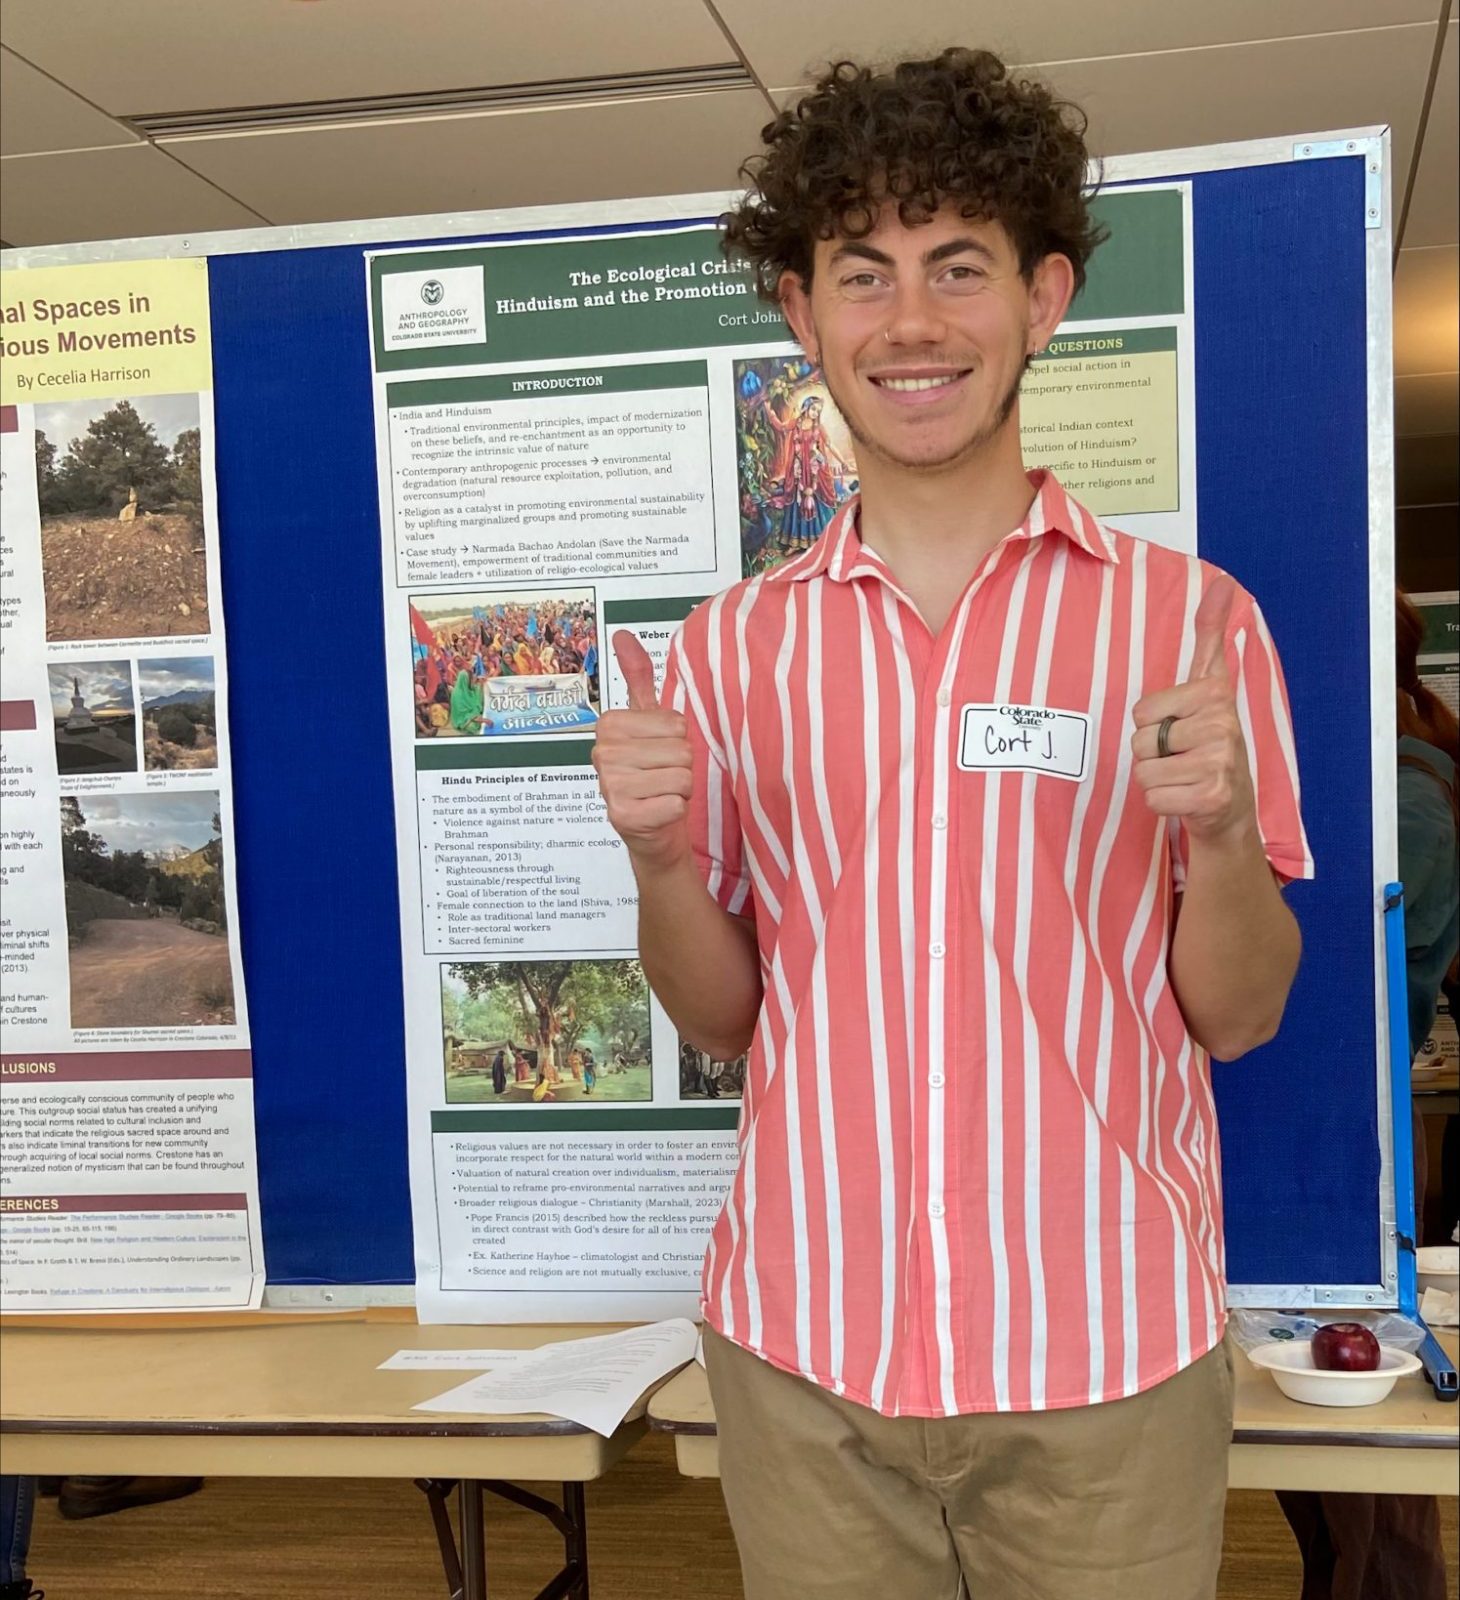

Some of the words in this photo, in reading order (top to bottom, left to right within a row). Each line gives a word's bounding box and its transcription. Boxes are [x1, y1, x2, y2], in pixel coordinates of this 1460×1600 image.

[570, 271, 602, 287] The
[607, 262, 696, 284] Ecological
[496, 295, 578, 315] Hinduism
[584, 291, 616, 308] and
[620, 288, 650, 304] the
[655, 281, 747, 302] Promotion
[33, 299, 121, 324] Spaces
[129, 292, 150, 314] in
[400, 309, 468, 320] ANTHROPOLOGY
[398, 322, 416, 330] AND
[418, 318, 469, 328] GEOGRAPHY
[718, 314, 748, 326] Cort
[58, 324, 196, 352] Movements
[1048, 338, 1124, 354] QUESTIONS
[1121, 360, 1131, 369] in
[17, 374, 34, 390] By
[37, 370, 86, 386] Cecelia
[90, 366, 150, 382] Harrison
[512, 376, 604, 392] INTRODUCTION
[1076, 376, 1152, 392] environmental
[399, 410, 423, 421] India
[425, 408, 443, 419] and
[445, 407, 492, 417] Hinduism
[409, 423, 461, 436] Traditional
[463, 419, 532, 432] environmental
[534, 416, 584, 430] principles,
[586, 414, 620, 426] impact
[622, 412, 632, 422] of
[634, 409, 703, 421] modernization
[457, 448, 472, 457] the
[517, 444, 543, 454] value
[545, 443, 555, 452] of
[1067, 441, 1078, 450] of
[401, 466, 468, 477] Contemporary
[470, 461, 538, 473] anthropogenic
[540, 459, 588, 471] processes
[602, 452, 671, 465] environmental
[654, 464, 673, 475] and
[1078, 461, 1089, 470] to
[1145, 457, 1157, 465] or
[1135, 474, 1155, 485] and
[639, 630, 670, 639] Weber
[1000, 706, 1056, 719] Colorado
[1012, 715, 1042, 726] State
[985, 725, 1032, 754] Cort
[1042, 730, 1057, 759] J.
[442, 776, 472, 785] Hindu
[475, 774, 525, 785] Principles
[527, 773, 538, 783] of
[4, 842, 21, 850] with
[22, 841, 43, 850] each
[21, 1096, 37, 1104] and
[177, 1092, 185, 1102] of
[217, 1092, 235, 1101] who
[19, 1107, 37, 1116] This
[128, 1105, 144, 1114] has
